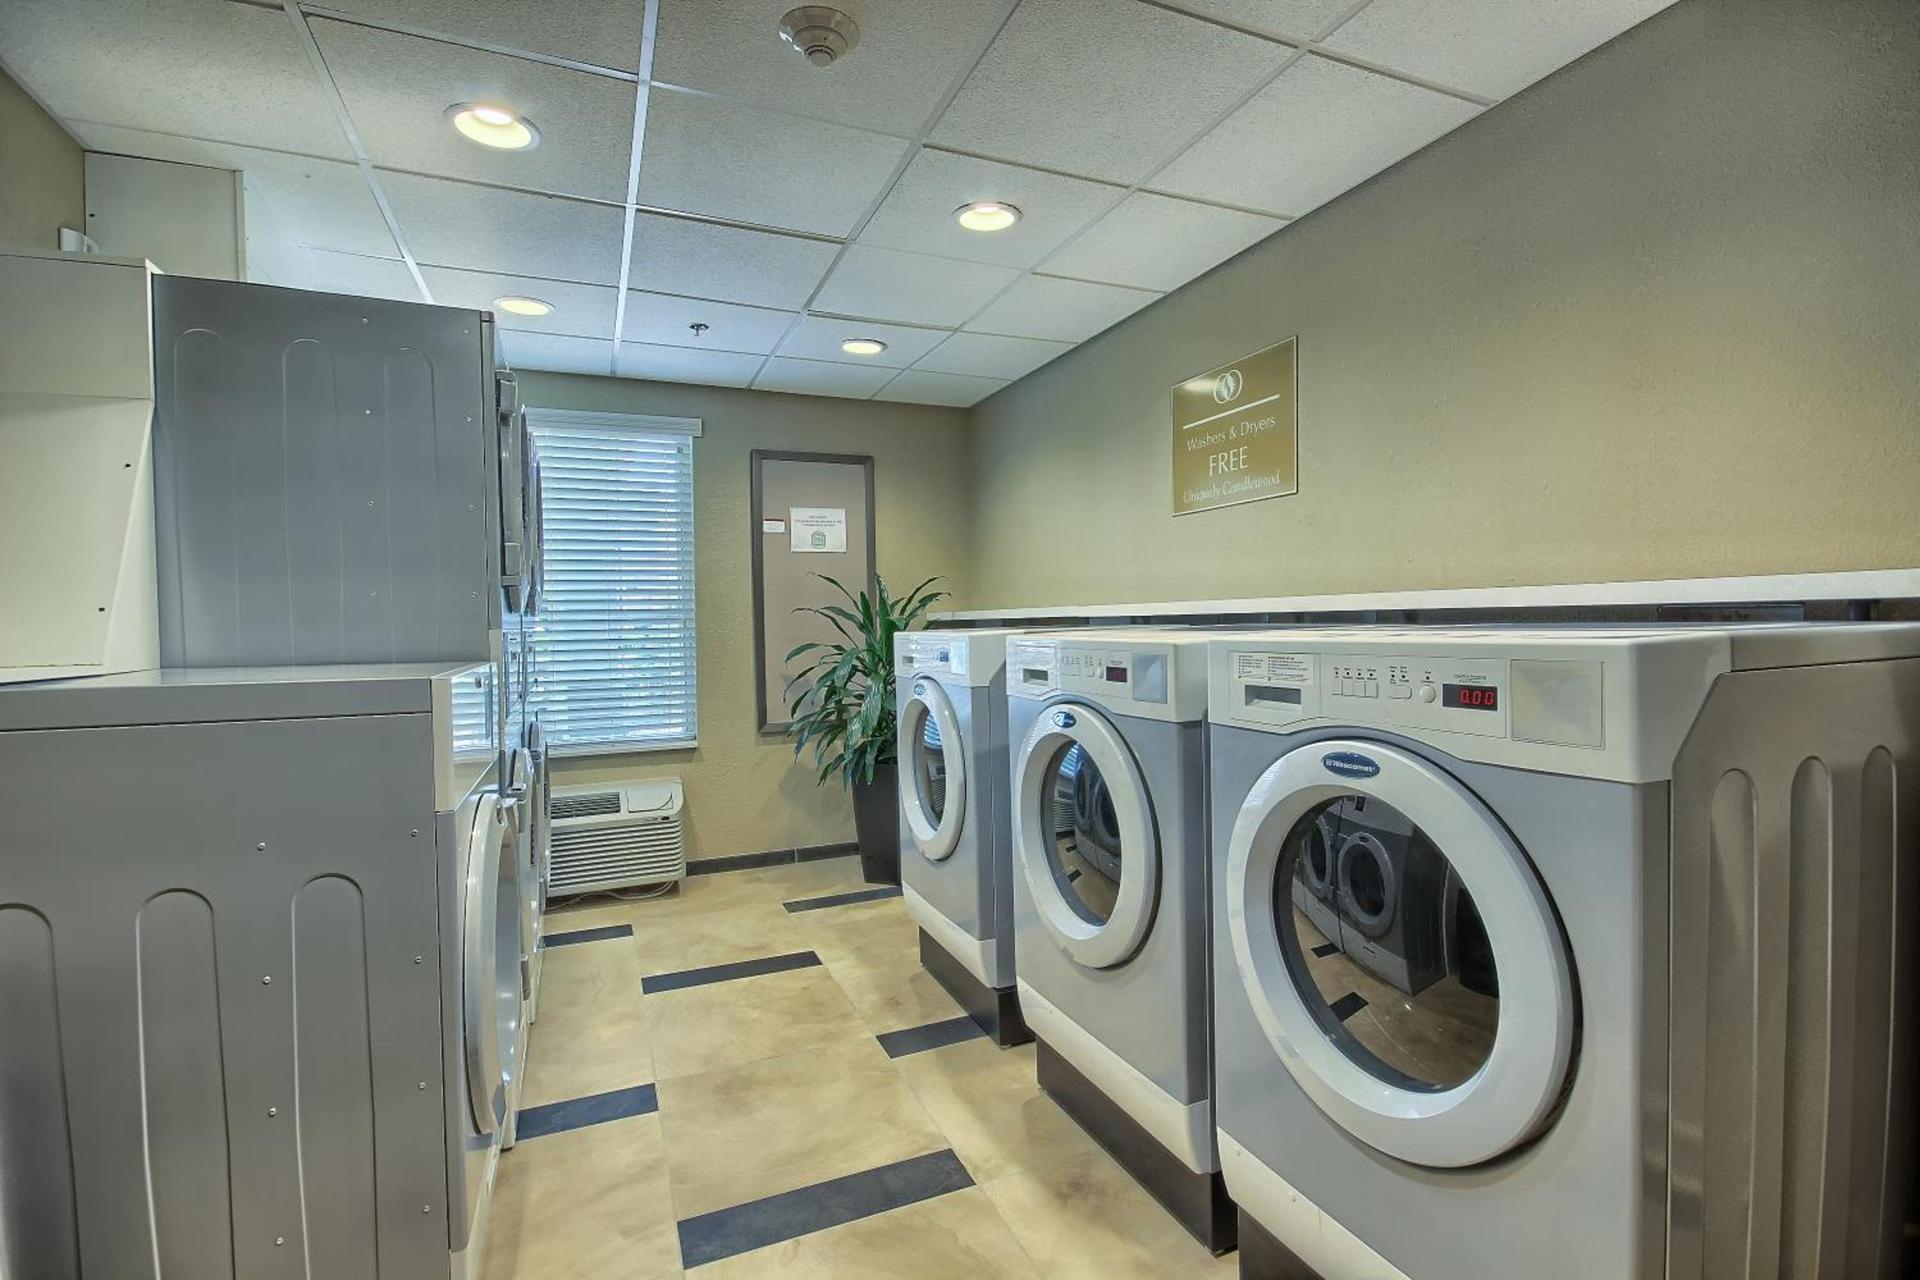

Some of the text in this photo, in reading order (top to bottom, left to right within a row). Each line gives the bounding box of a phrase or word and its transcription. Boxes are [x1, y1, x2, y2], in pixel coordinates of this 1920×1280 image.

[1187, 416, 1276, 452] Washers & Dryers
[1209, 446, 1248, 477] FREE
[1222, 473, 1281, 496] Candlewood
